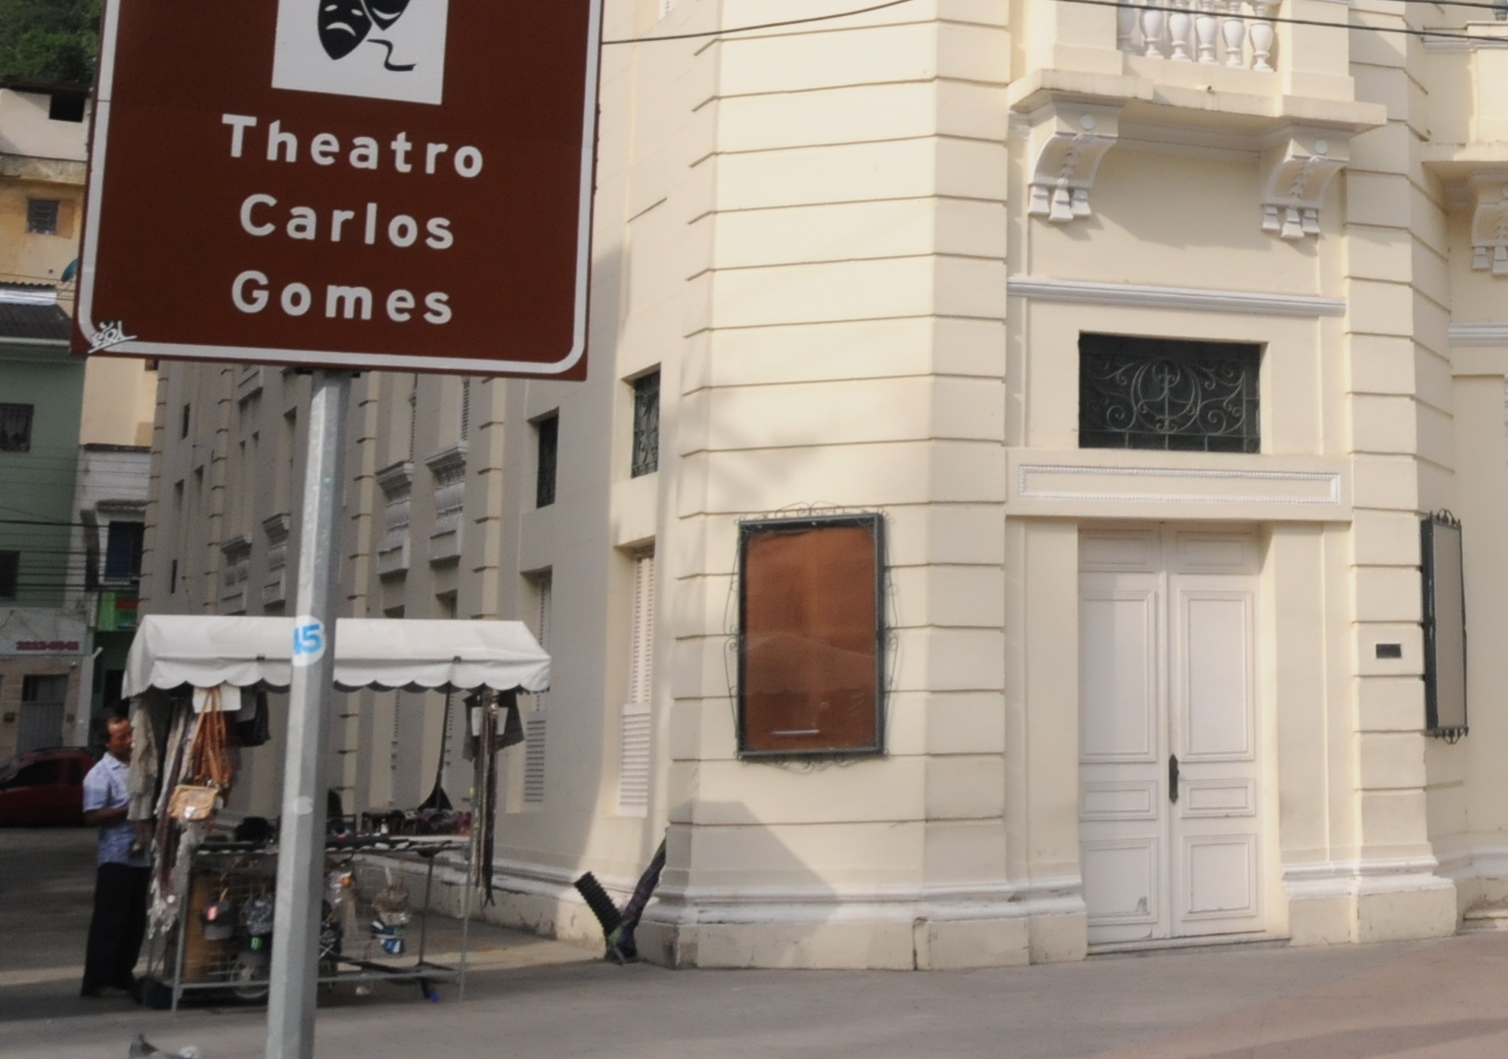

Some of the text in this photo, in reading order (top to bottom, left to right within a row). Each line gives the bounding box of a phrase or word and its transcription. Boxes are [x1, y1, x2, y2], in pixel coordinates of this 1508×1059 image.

[221, 113, 484, 178] Theatro
[239, 193, 454, 250] Carlos
[231, 269, 453, 325] Gomes
